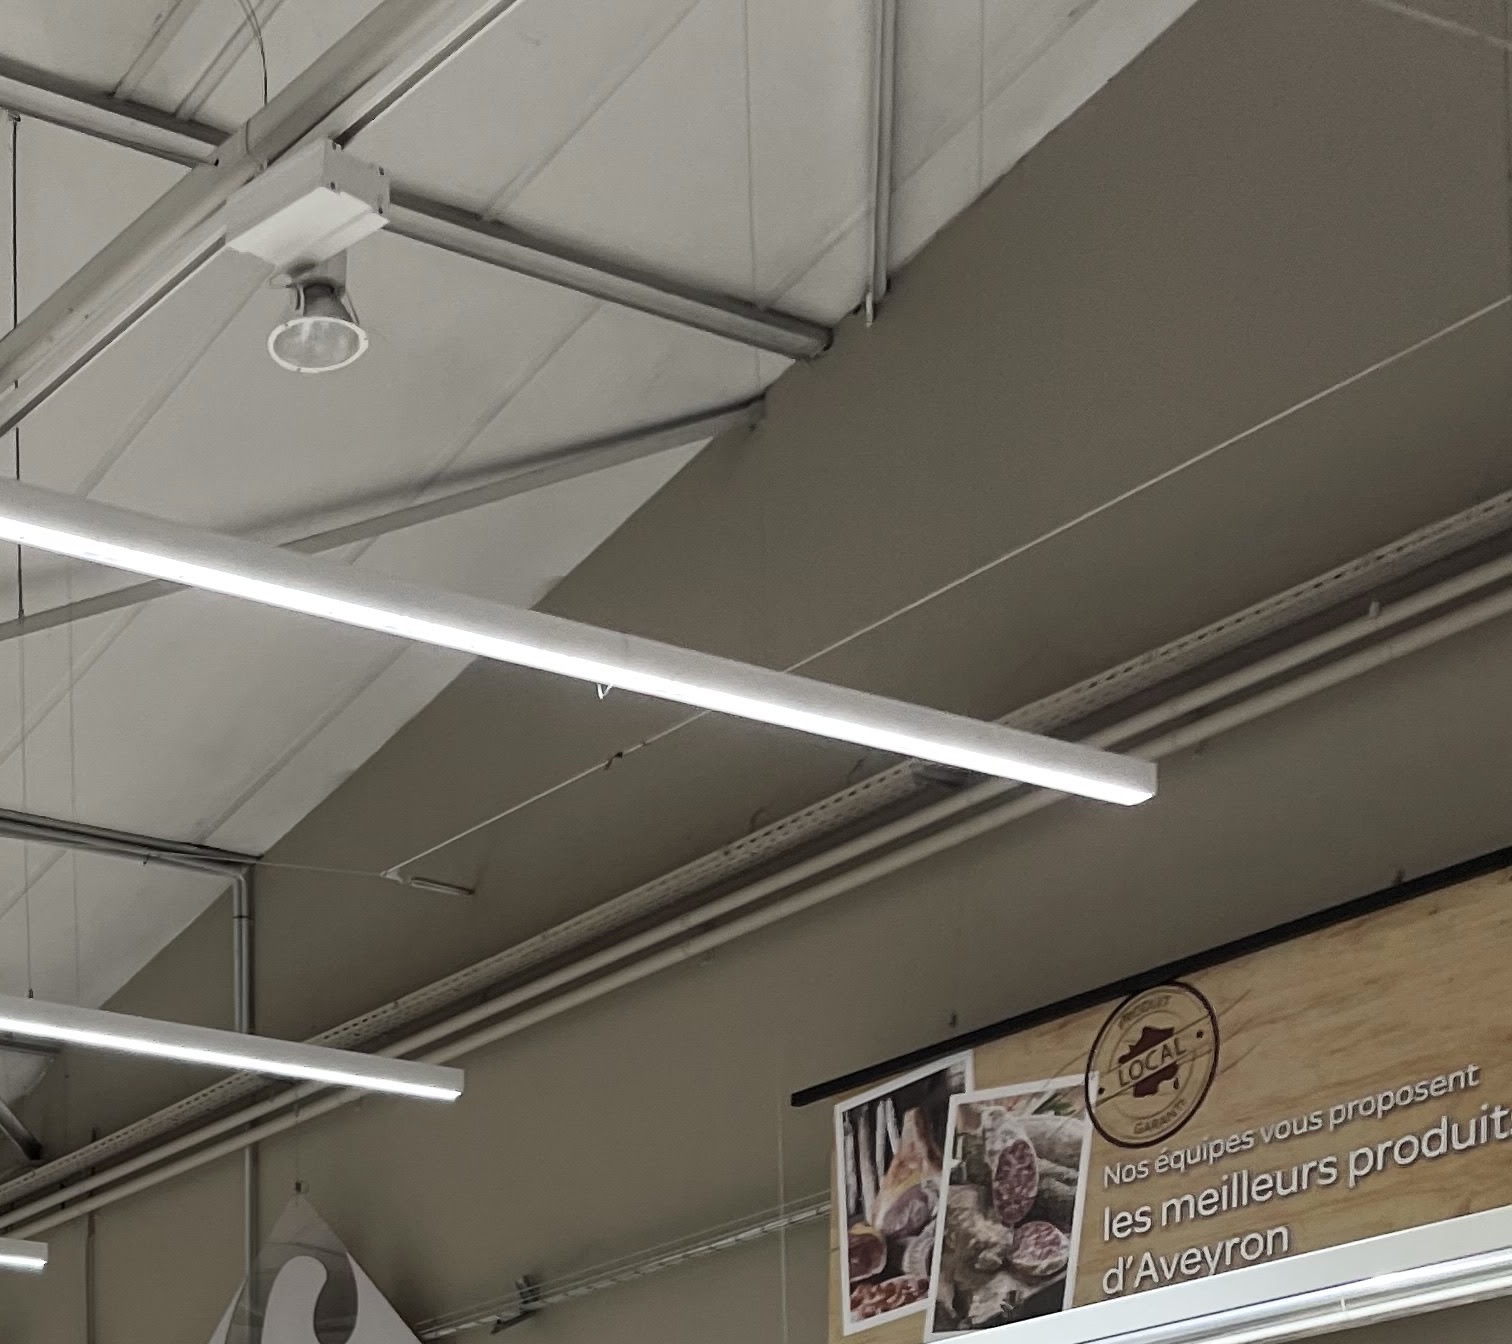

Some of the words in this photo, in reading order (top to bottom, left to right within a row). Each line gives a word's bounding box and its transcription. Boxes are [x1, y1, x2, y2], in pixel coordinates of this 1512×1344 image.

[1119, 1037, 1186, 1087] LOCAL
[1104, 1158, 1149, 1188] Nos
[1154, 1129, 1255, 1175] équipes
[1260, 1108, 1325, 1144] vous
[1329, 1063, 1483, 1132] proposent
[1103, 1205, 1153, 1241] les
[1161, 1155, 1339, 1227] meilleurs
[1102, 1225, 1290, 1297] d'Aveyron
